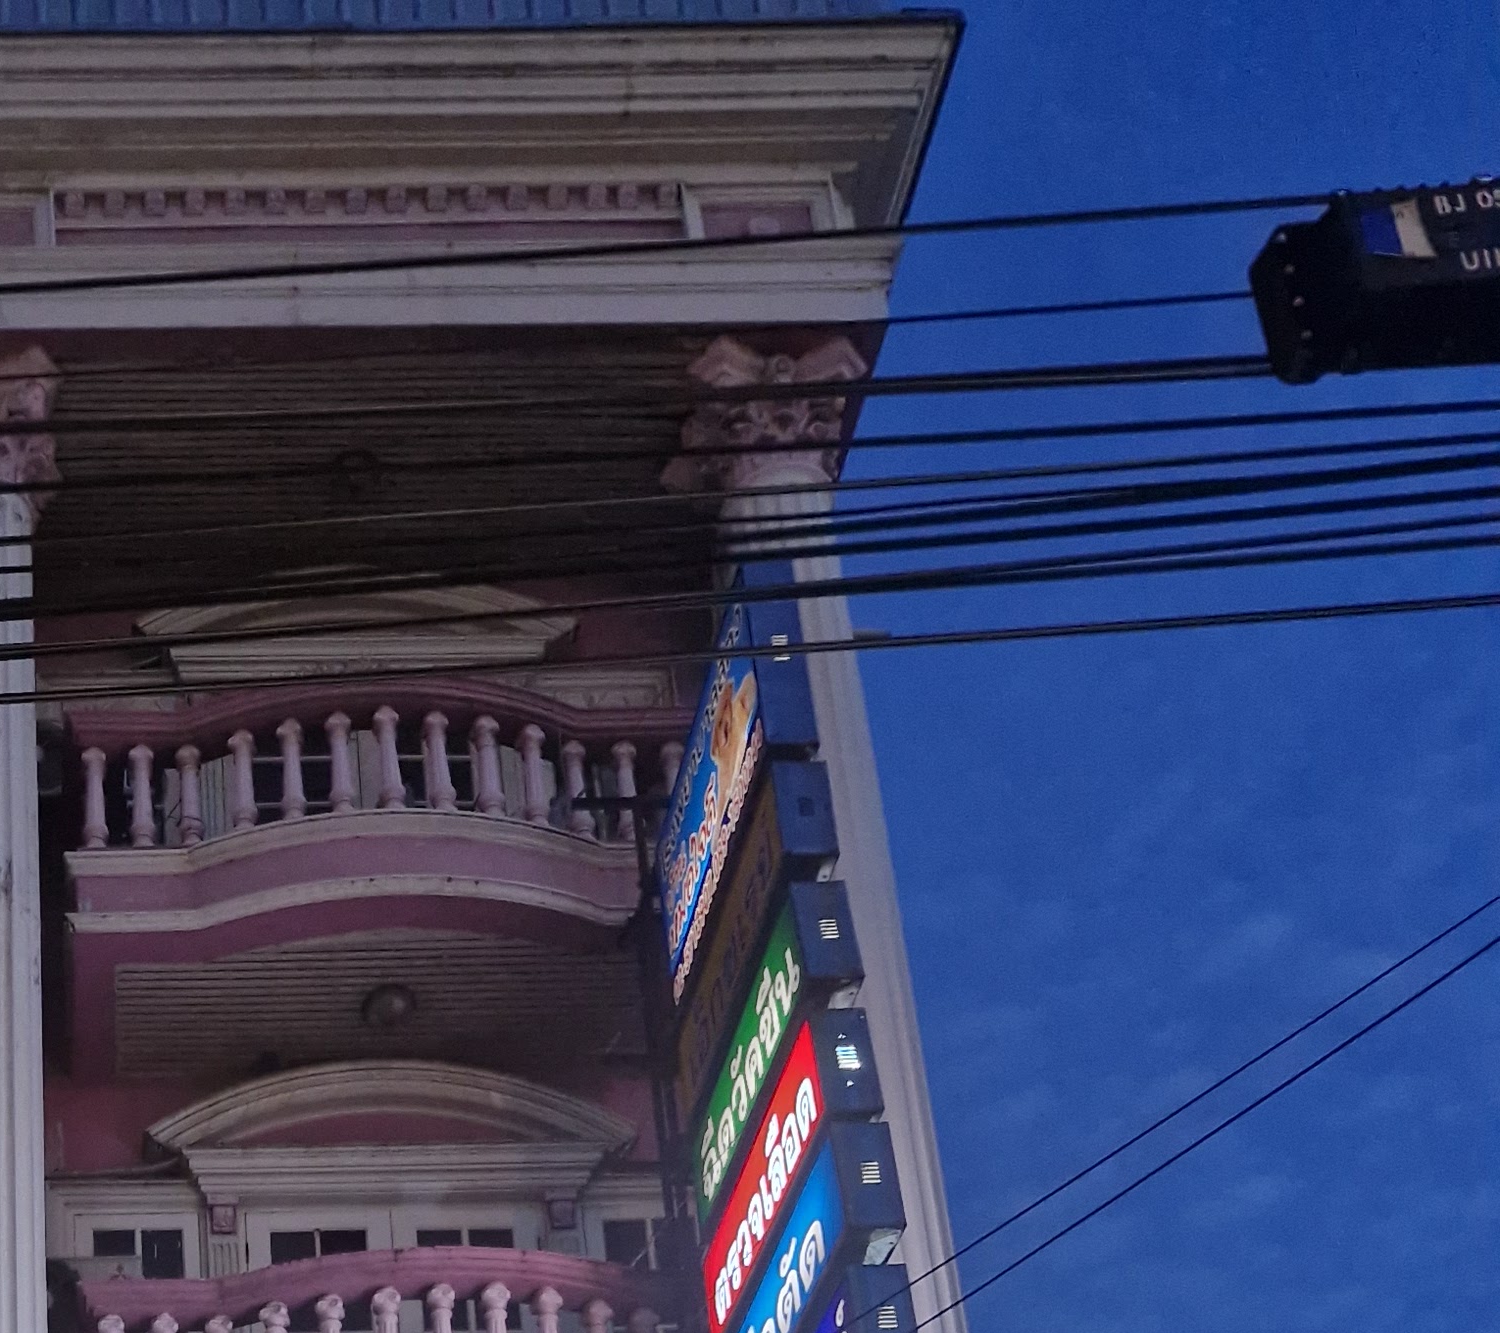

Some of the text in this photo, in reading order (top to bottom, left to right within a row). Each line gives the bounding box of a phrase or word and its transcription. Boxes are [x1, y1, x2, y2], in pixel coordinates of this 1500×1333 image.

[701, 948, 800, 1201] ฉีดวัคซีน
[712, 1076, 820, 1330] ตรวจเลือด
